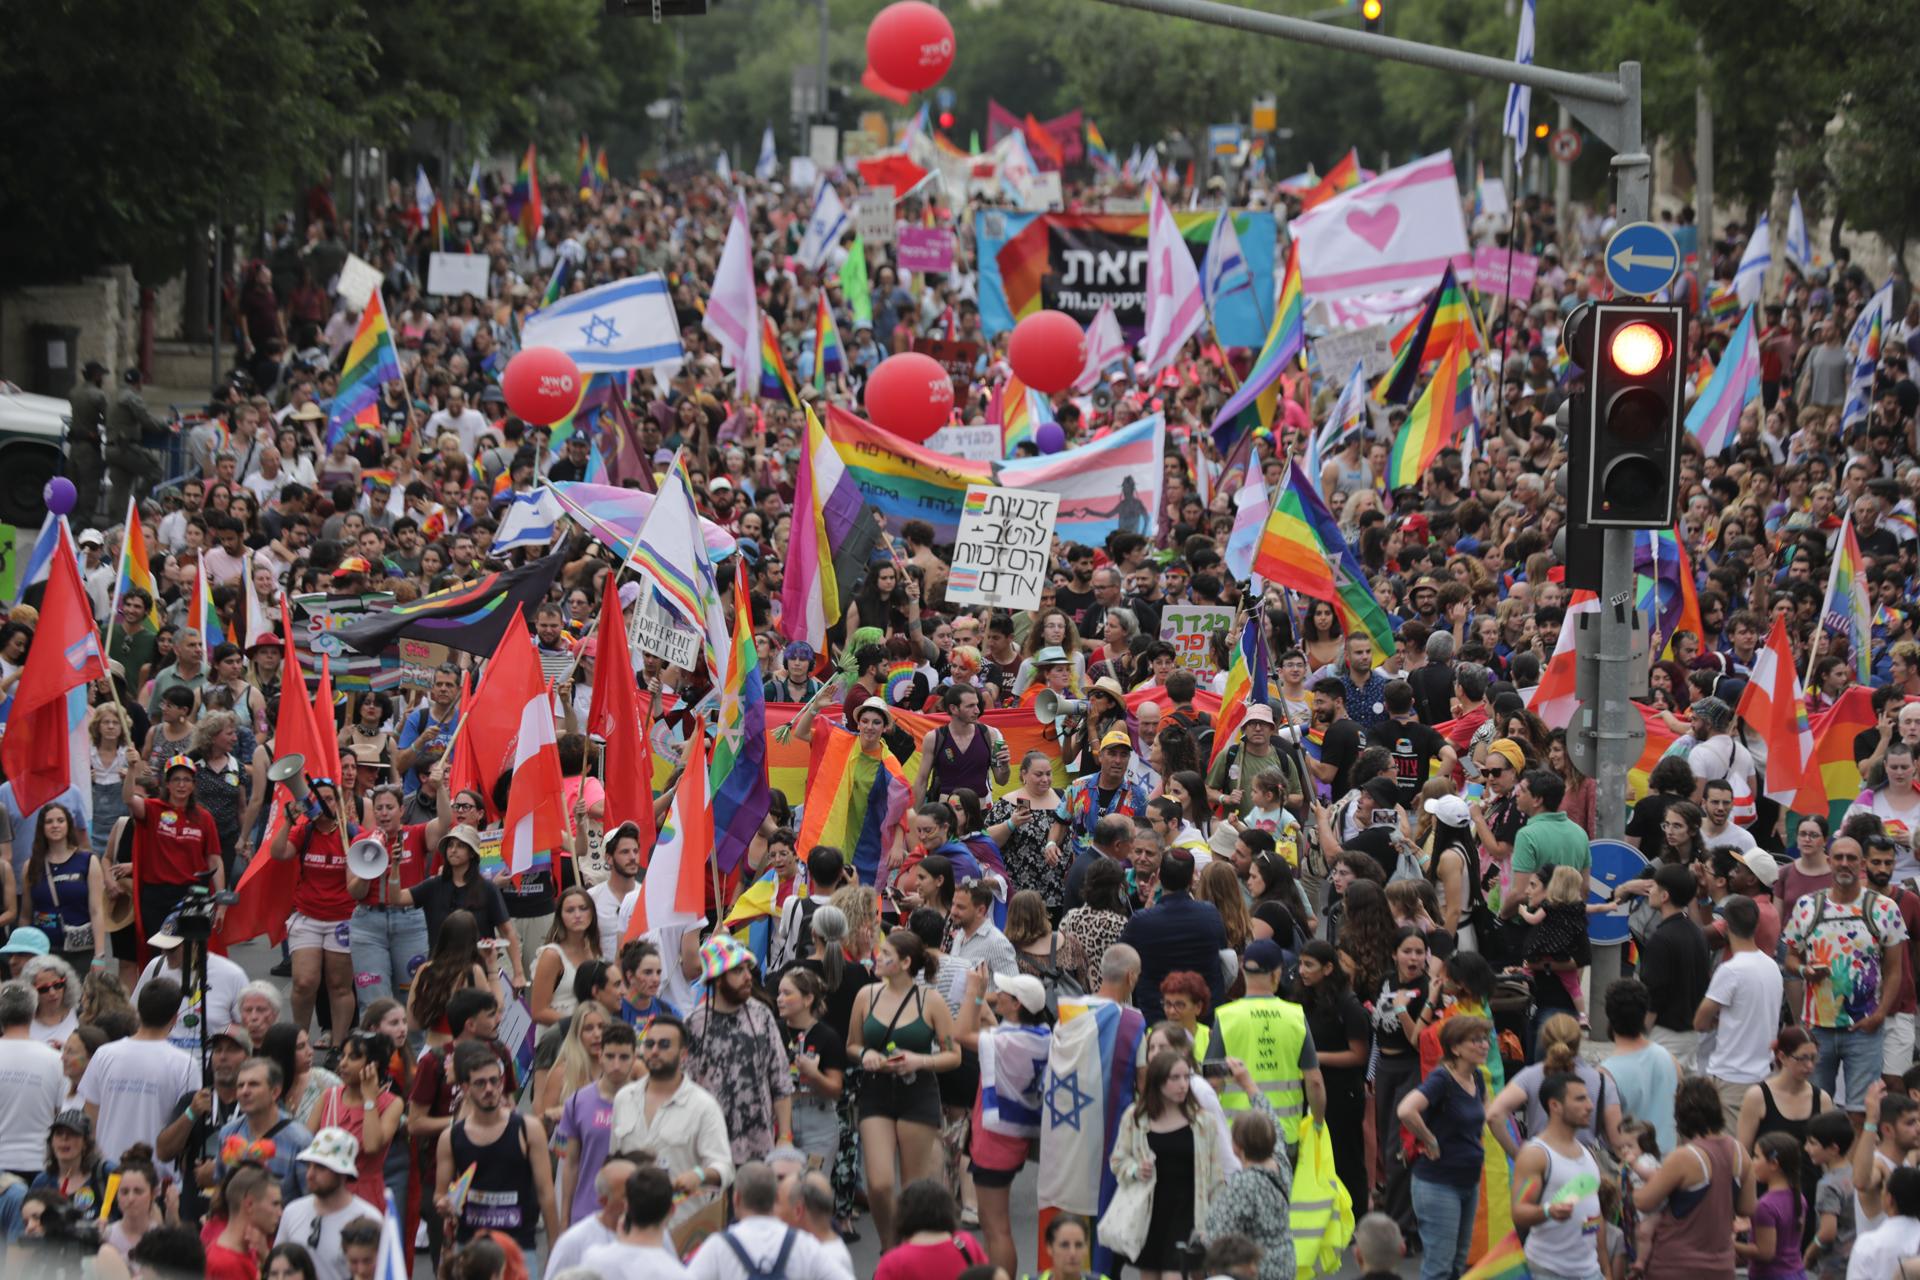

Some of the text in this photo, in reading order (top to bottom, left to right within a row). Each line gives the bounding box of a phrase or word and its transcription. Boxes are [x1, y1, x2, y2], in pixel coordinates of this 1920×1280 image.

[983, 495, 1054, 520] זכויות
[953, 542, 1044, 573] הם זכויות
[979, 571, 1038, 597] אדם
[1612, 592, 1629, 604] 1UP
[640, 617, 691, 650] DIFFERENT
[1168, 613, 1231, 633] מגדר
[637, 632, 689, 666] NOT LESS
[1250, 1010, 1281, 1019] MAMA
[1256, 1062, 1278, 1071] MOM
